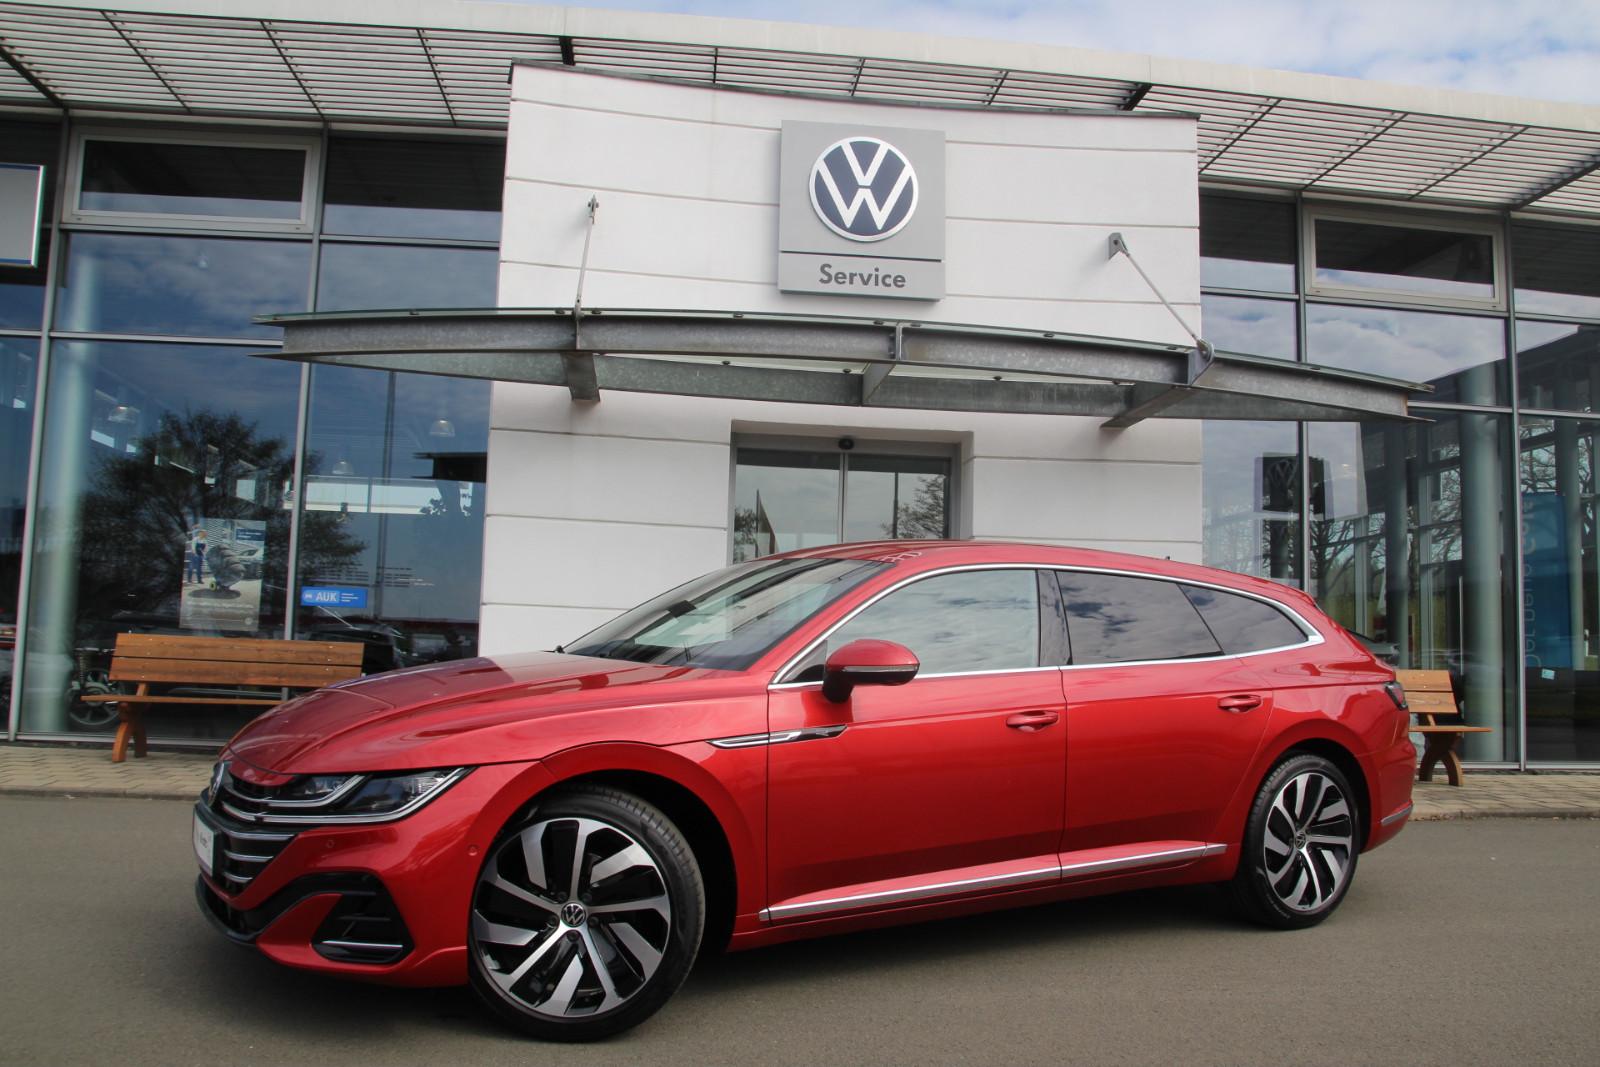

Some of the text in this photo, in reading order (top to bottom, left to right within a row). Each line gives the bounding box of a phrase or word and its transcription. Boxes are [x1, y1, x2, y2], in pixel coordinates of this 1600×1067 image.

[812, 138, 916, 238] VW
[819, 263, 906, 288] Service
[316, 591, 336, 602] AUK
